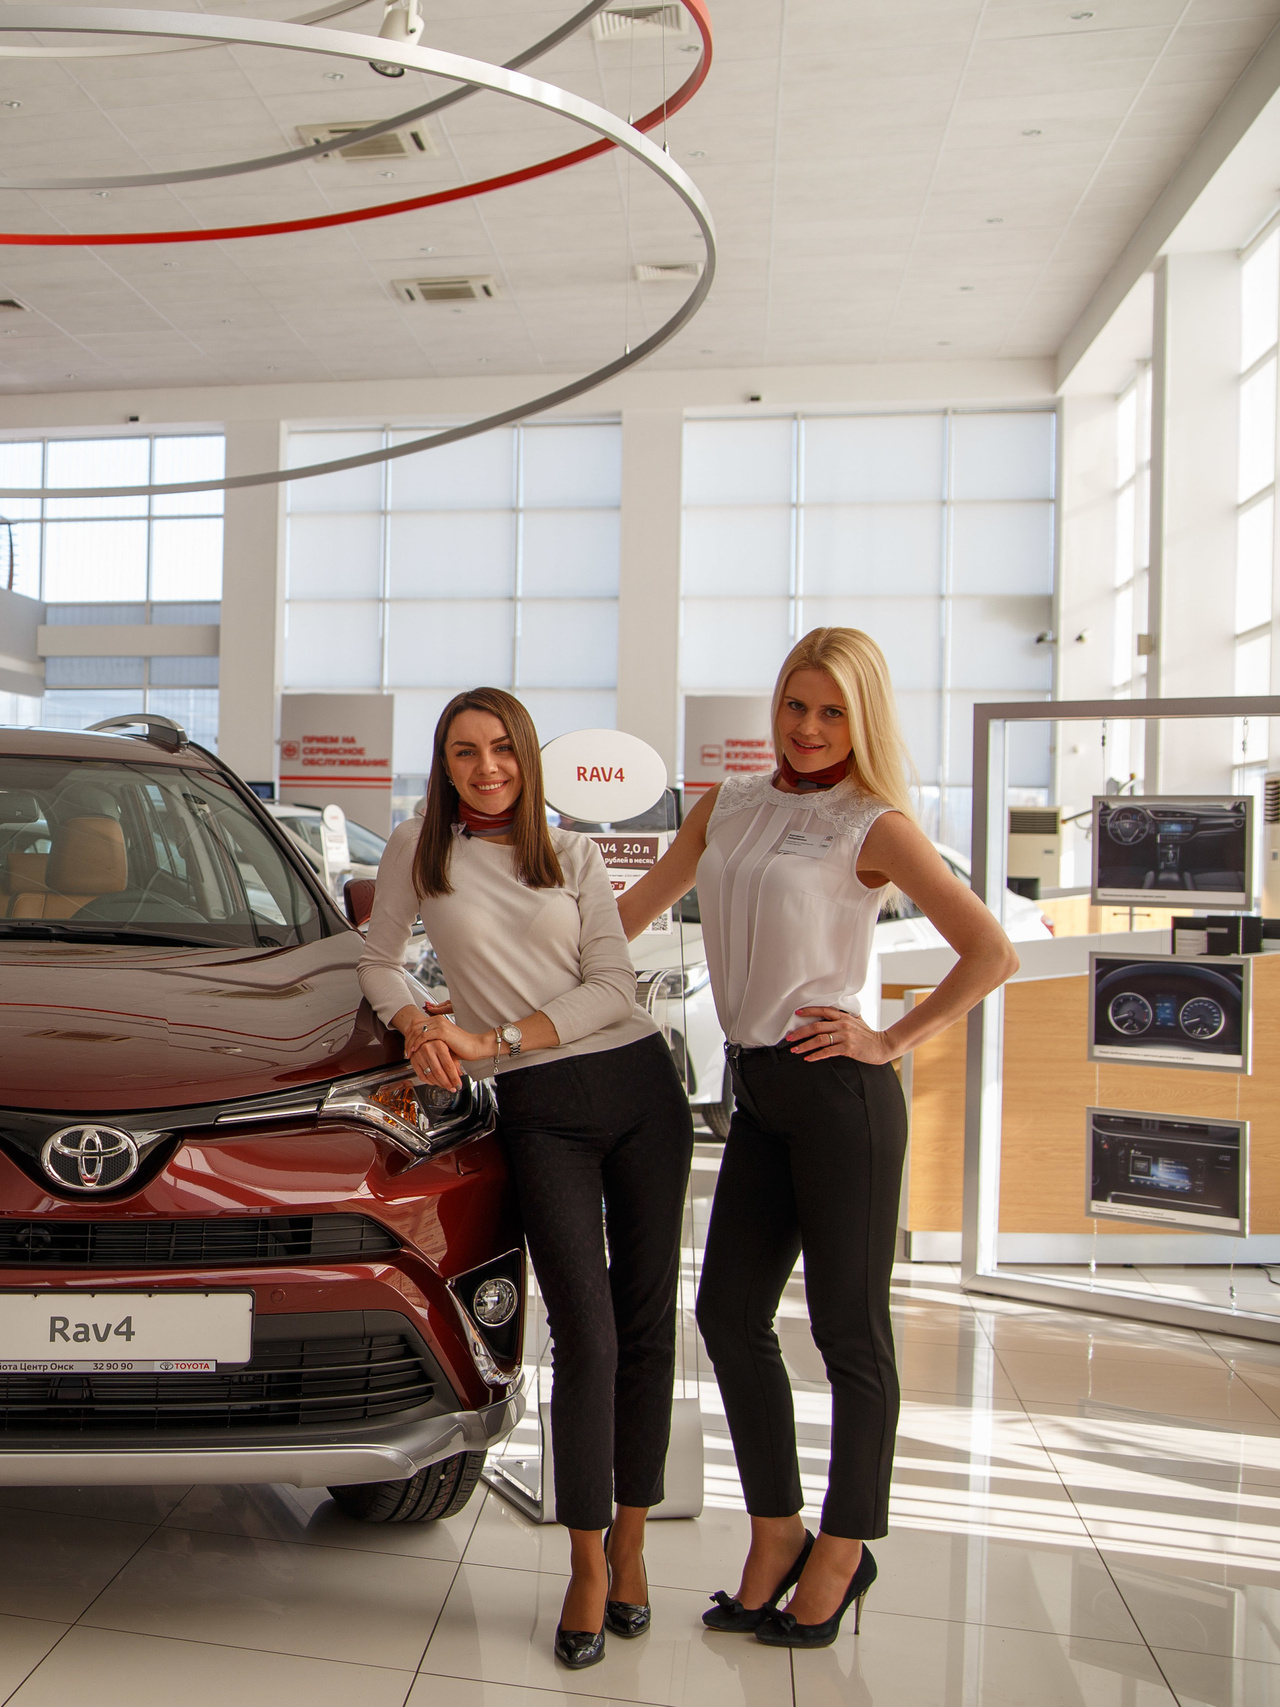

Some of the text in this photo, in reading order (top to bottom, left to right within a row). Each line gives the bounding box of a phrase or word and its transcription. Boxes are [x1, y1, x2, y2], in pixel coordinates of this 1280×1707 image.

[341, 736, 356, 744] НА
[302, 746, 365, 756] СЕРВИСНОЕ
[302, 757, 389, 767] ОБСЛУЖИВАНИЕ
[576, 766, 625, 782] RAV4
[600, 842, 650, 855] V4 2,0 л
[604, 856, 628, 865] рублей
[49, 1315, 136, 1343] Rav4
[19, 1362, 48, 1372] Центр
[50, 1362, 74, 1371] Омск
[93, 1362, 133, 1370] 32 90 90
[174, 1362, 210, 1370] TOYOTA
